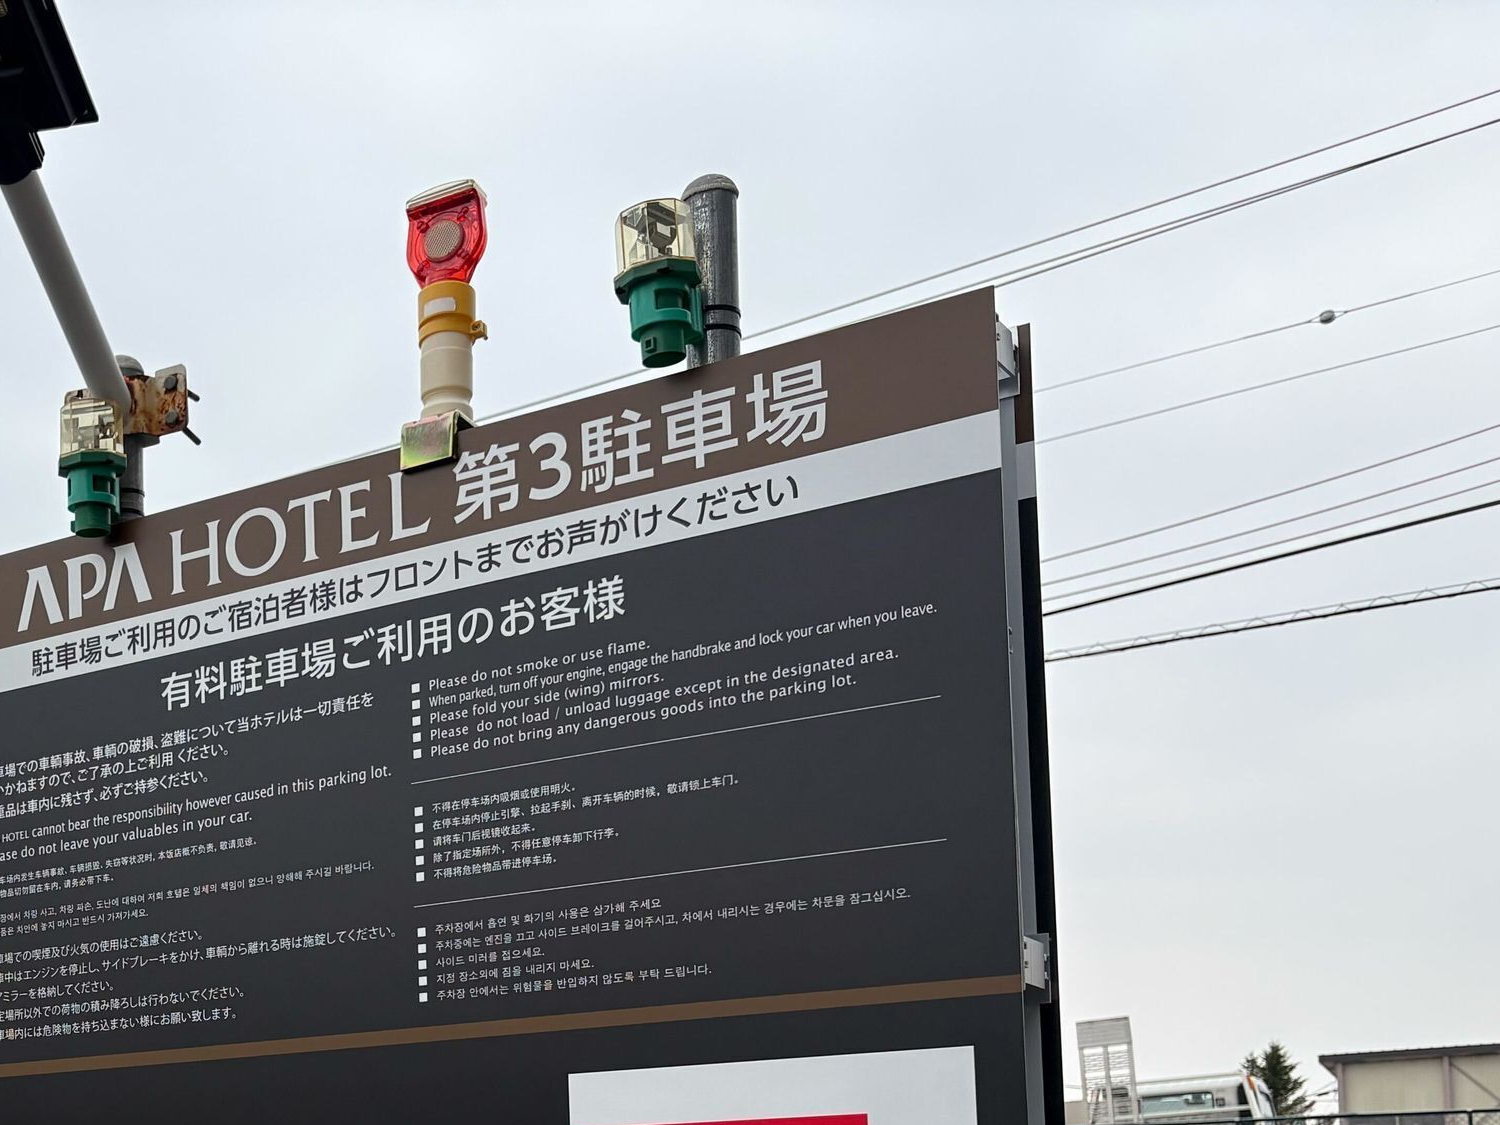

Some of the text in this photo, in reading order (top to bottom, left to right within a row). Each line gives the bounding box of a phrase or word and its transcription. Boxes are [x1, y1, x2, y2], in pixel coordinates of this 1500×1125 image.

[16, 359, 828, 633] APA HOTEL 第3駐車場
[31, 475, 799, 677] 駐車場ご利用のご宿泊者様はフロントまでお声がけください
[160, 574, 625, 711] 有料駐車場ご利用のお客様
[428, 603, 937, 707] When parked, turn off your engine, engage the handbrake and lock your car when you leave.
[428, 639, 650, 691] Please do not smoke or use flame.
[429, 725, 469, 741] Please
[476, 719, 493, 732] do
[496, 715, 518, 729] not
[521, 707, 549, 724] load
[564, 696, 611, 716] unload
[614, 688, 670, 708] luggage
[674, 678, 722, 697] except
[726, 675, 739, 688] in
[743, 670, 767, 685] the
[771, 652, 855, 680] designated
[859, 648, 899, 664] area.
[429, 672, 664, 724] Please fold your side (wing) mirrors.
[430, 674, 857, 757] Please do not bring any dangerous goods into the parking lot.
[1, 829, 30, 843] HOTEL
[31, 822, 65, 838] cannot
[67, 818, 91, 831] bear
[92, 813, 110, 827] the
[111, 801, 183, 824] responsibility
[185, 793, 232, 811] however
[233, 783, 274, 803] caused
[277, 782, 289, 795] in
[291, 777, 315, 793] this
[318, 769, 367, 791] parking
[370, 764, 391, 779] lot.
[20, 845, 35, 858] do
[38, 842, 57, 855] not
[59, 837, 89, 851] leave
[91, 832, 119, 849] your
[121, 821, 179, 841] valuables
[182, 819, 194, 832] in
[196, 814, 226, 832] your
[229, 810, 252, 824] car.
